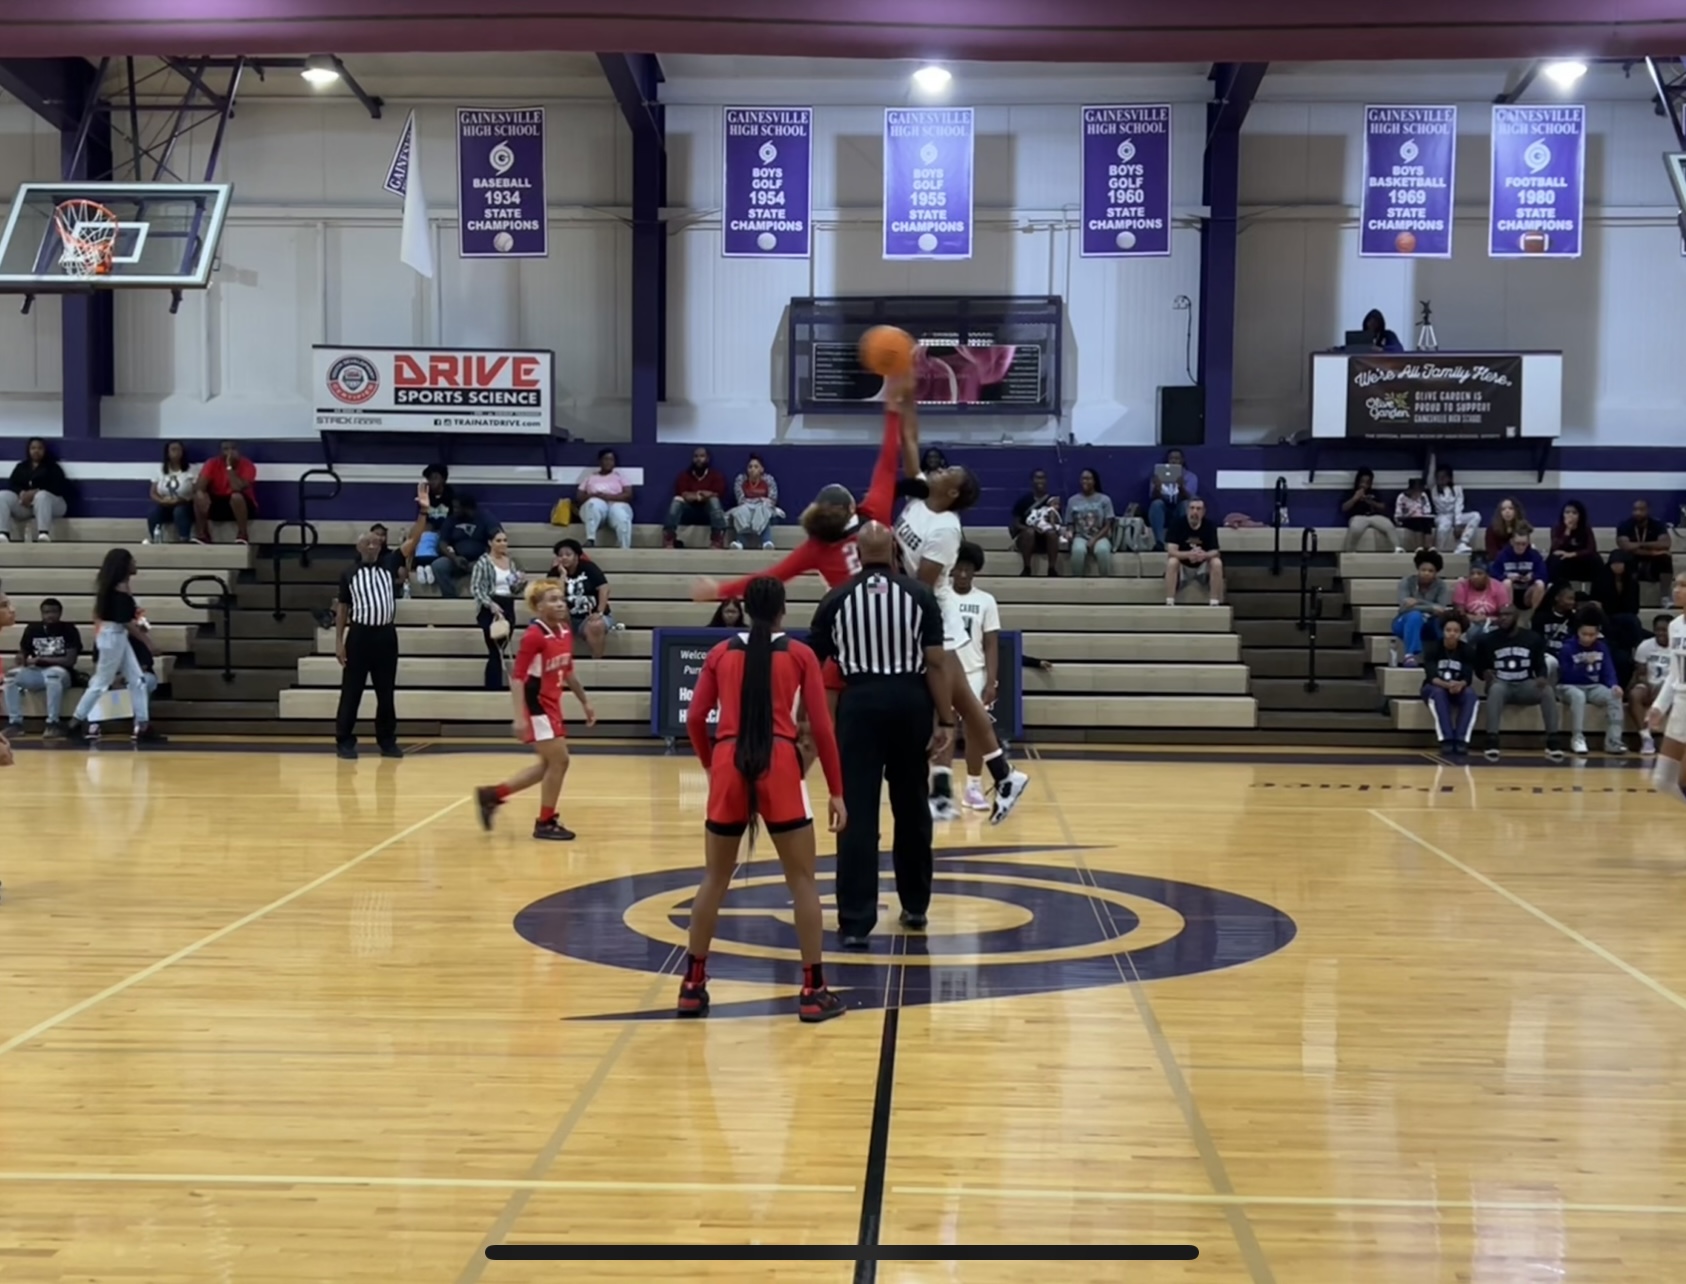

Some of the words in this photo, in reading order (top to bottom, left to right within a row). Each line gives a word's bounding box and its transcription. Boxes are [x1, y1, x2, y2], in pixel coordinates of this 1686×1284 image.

[461, 112, 541, 124] GAINESVILLE
[728, 111, 808, 124] GAINESVILLE
[888, 112, 970, 124] GAINESVILLE
[1085, 109, 1167, 122] GAINESVILLE
[1369, 109, 1453, 122] GAINESVILLE
[1497, 109, 1581, 122] GAINESVILLE
[463, 125, 491, 136] HIGH
[494, 125, 540, 136] SCHOOL
[730, 125, 758, 136] HIGH
[761, 125, 807, 136] SCHOOL
[890, 125, 920, 137] HIGH
[922, 125, 968, 137] SCHOOL
[1087, 123, 1117, 135] HIGH
[1119, 122, 1166, 134] SCHOOL
[1370, 123, 1400, 134] HIGH
[1402, 123, 1450, 134] SCHOOL
[1497, 123, 1528, 134] HIGH
[1531, 123, 1579, 134] SCHOOL
[752, 168, 783, 178] BOYS
[913, 169, 944, 179] BOYS
[1109, 164, 1144, 176] BOYS
[1392, 166, 1424, 176] BOYS
[473, 178, 532, 188] BASEBALL
[752, 179, 783, 189] GOLF
[913, 180, 944, 190] GOLF
[1108, 177, 1144, 189] GOLF
[1369, 177, 1447, 187] BASKETBALL
[1505, 177, 1568, 187] FOOTBALL
[485, 190, 521, 205] 1934
[749, 191, 785, 205] 1954
[910, 192, 946, 206] 1955
[1107, 190, 1144, 203] 1960
[1388, 190, 1426, 204] 1969
[1517, 190, 1556, 204] 1980
[484, 209, 522, 218] STATE
[748, 209, 786, 219] STATE
[909, 210, 947, 220] STATE
[1106, 207, 1145, 217] STATE
[1387, 208, 1426, 218] STATE
[1516, 208, 1556, 218] STATE
[467, 220, 539, 230] CHAMPIONS
[730, 220, 803, 231] CHAMPIONS
[891, 221, 964, 232] CHAMPIONS
[1088, 219, 1162, 230] CHAMPIONS
[1368, 220, 1444, 230] CHAMPIONS
[1497, 220, 1573, 231] CHAMPIONS
[394, 355, 541, 387] DRIVE
[1354, 368, 1396, 387] We're
[1398, 364, 1420, 379] All
[1422, 363, 1471, 384] Family
[1472, 366, 1513, 387] Here.
[398, 390, 463, 404] SPORTS
[468, 391, 537, 404] SCIENCE
[1415, 391, 1437, 401] OLIVE
[1439, 391, 1471, 401] GARDEN
[1474, 391, 1482, 401] IS
[1366, 397, 1395, 409] Olive
[1414, 402, 1441, 412] PROUD
[1443, 402, 1454, 412] TO
[1456, 402, 1491, 412] SUPPORT
[1369, 406, 1410, 421] Garden
[454, 419, 541, 427] TRAINATDRIVE.com
